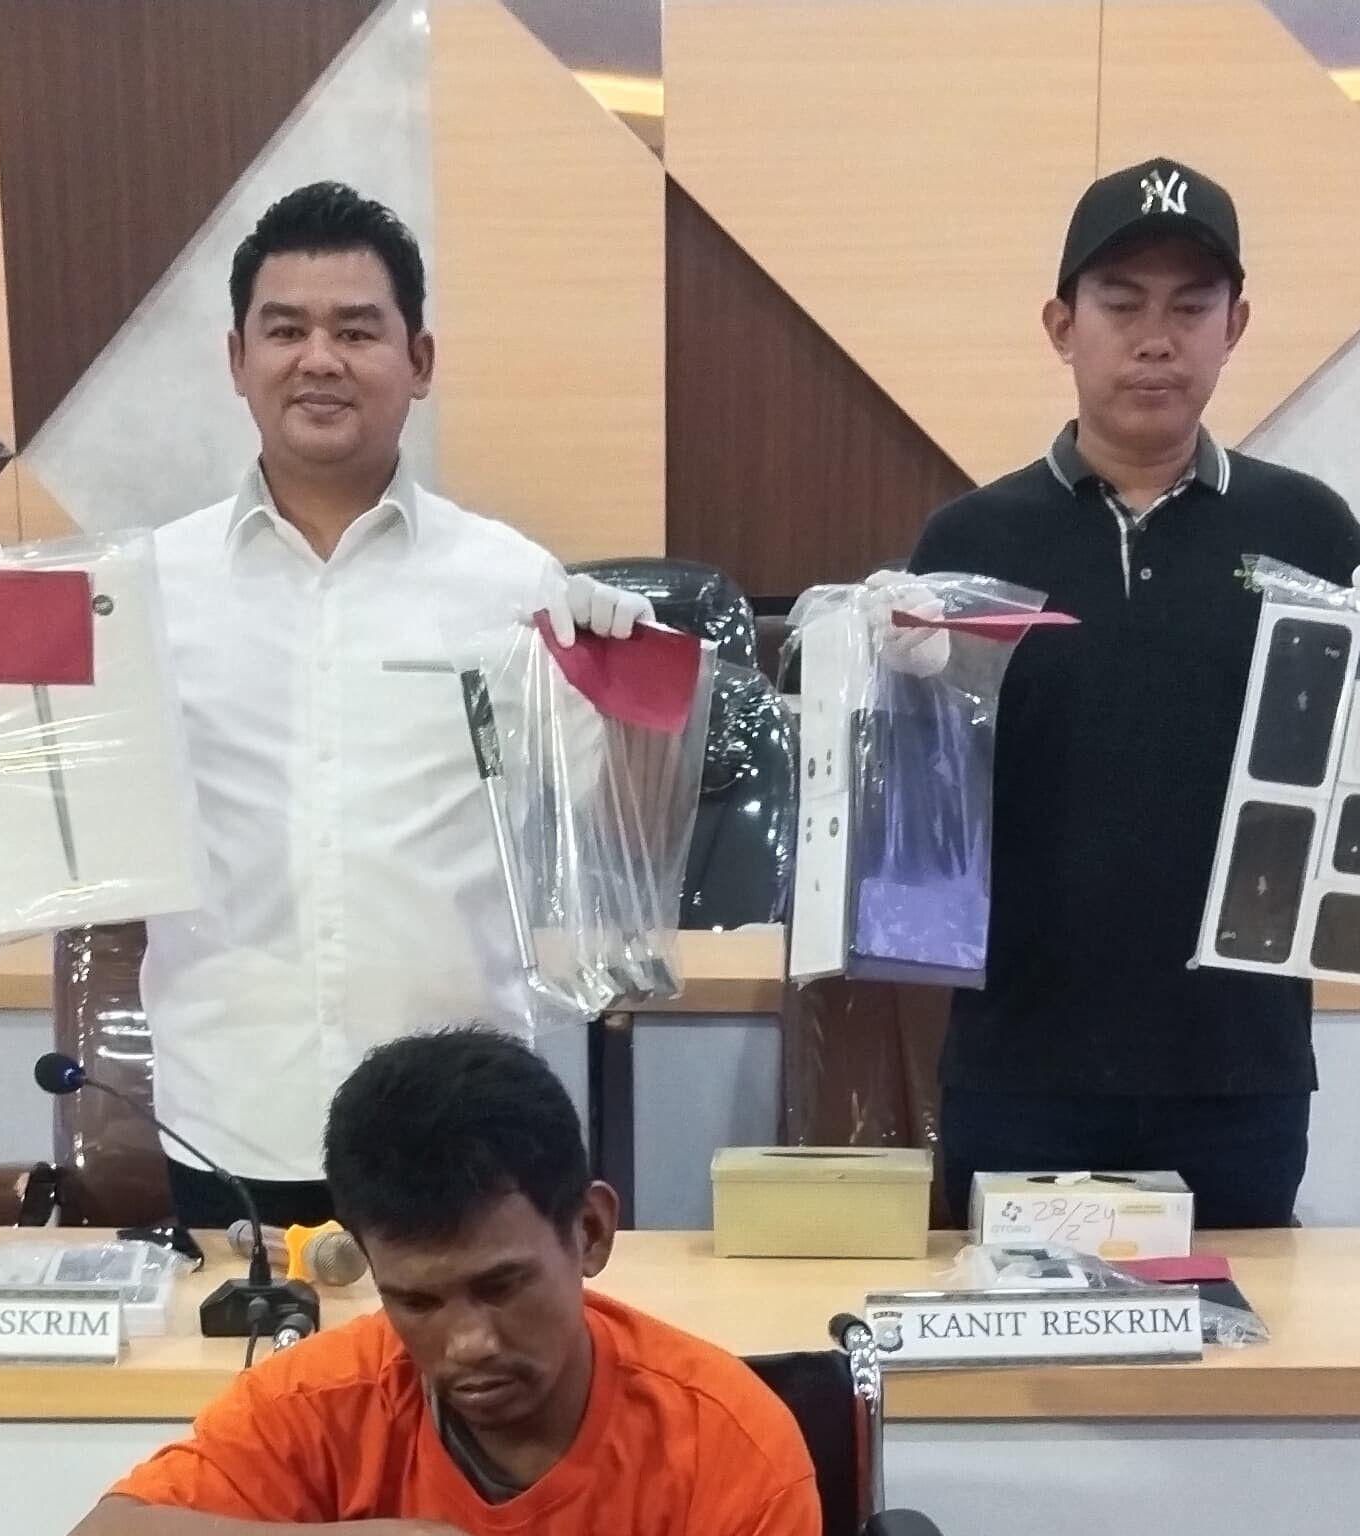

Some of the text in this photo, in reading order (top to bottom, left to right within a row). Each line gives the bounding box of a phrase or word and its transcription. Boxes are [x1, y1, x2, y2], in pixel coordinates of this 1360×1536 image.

[1140, 169, 1189, 215] NY
[917, 1308, 1192, 1339] KANIT RESKRIM
